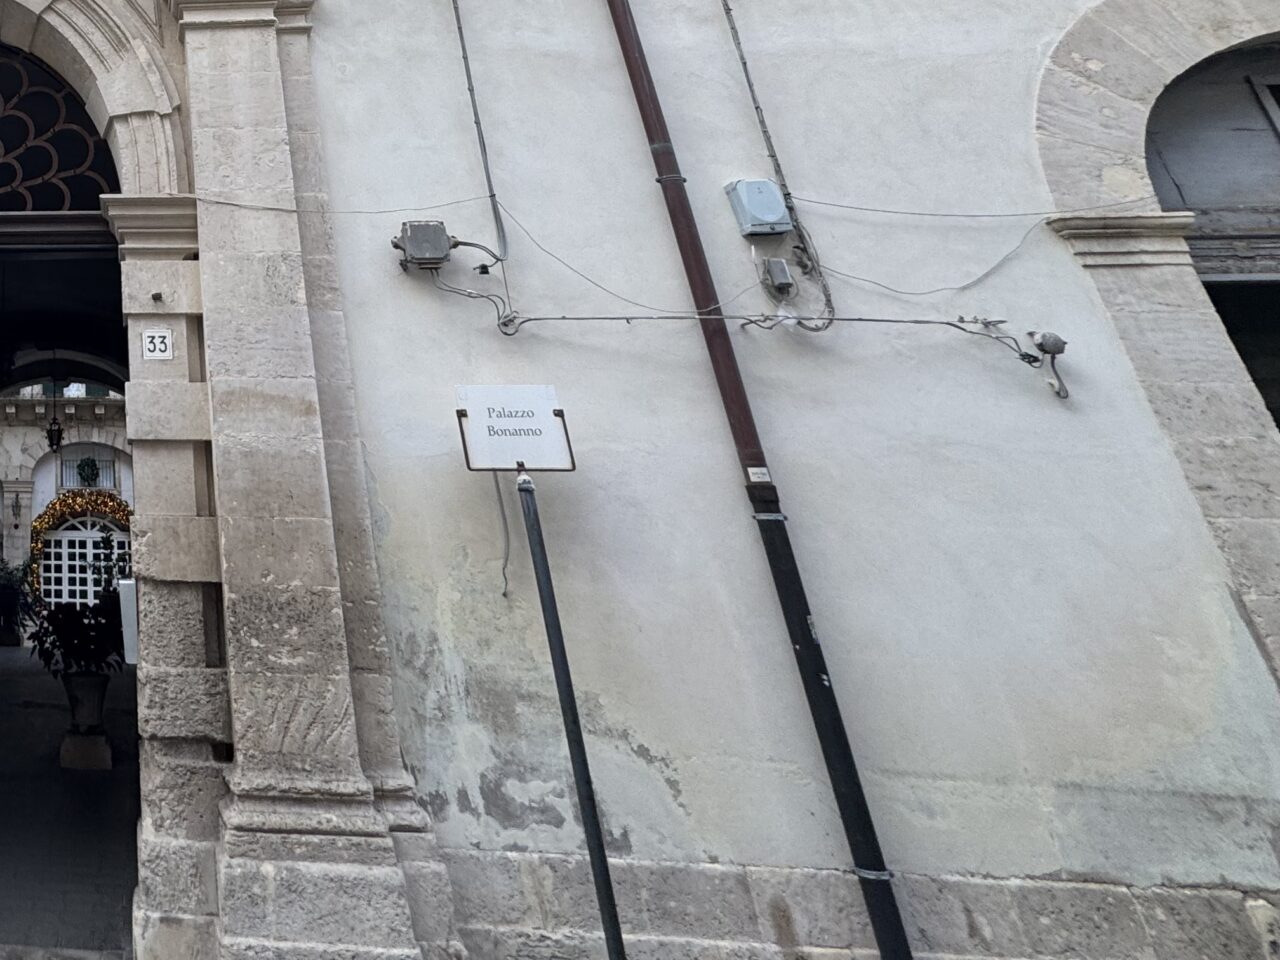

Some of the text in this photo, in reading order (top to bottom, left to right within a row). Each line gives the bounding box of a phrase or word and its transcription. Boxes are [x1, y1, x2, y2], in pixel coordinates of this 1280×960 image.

[147, 335, 168, 353] 33
[487, 407, 535, 419] Palazzo
[487, 425, 543, 437] Bonanno
